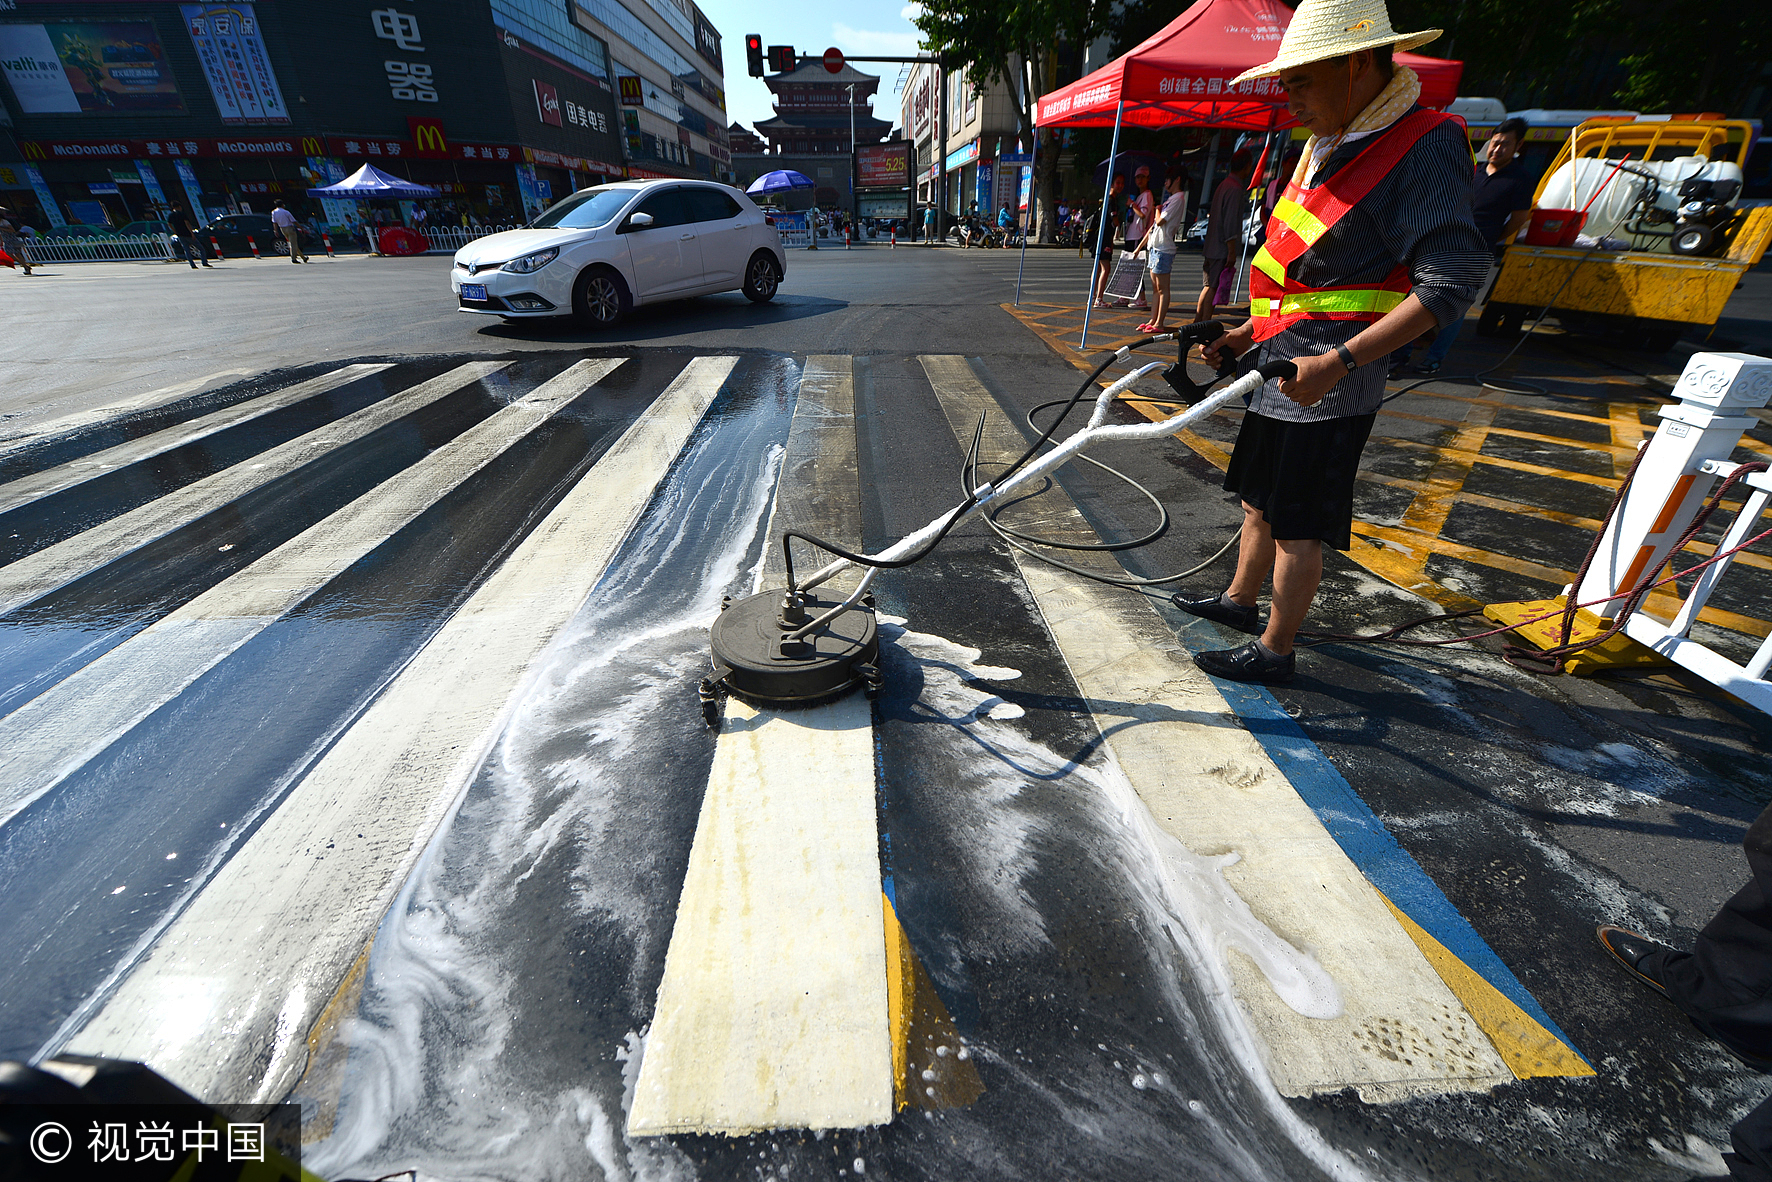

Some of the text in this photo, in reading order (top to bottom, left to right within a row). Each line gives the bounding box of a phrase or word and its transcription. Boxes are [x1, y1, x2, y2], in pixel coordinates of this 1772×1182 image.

[371, 8, 440, 102] 电器
[778, 48, 794, 71] 15
[565, 100, 608, 133] 国美电器
[53, 142, 129, 156] McDonald's
[146, 141, 199, 156] 麦当劳
[217, 140, 293, 154] McDonald's
[344, 141, 401, 155] 麦当劳
[463, 146, 510, 160] 麦当劳
[537, 181, 546, 193] P
